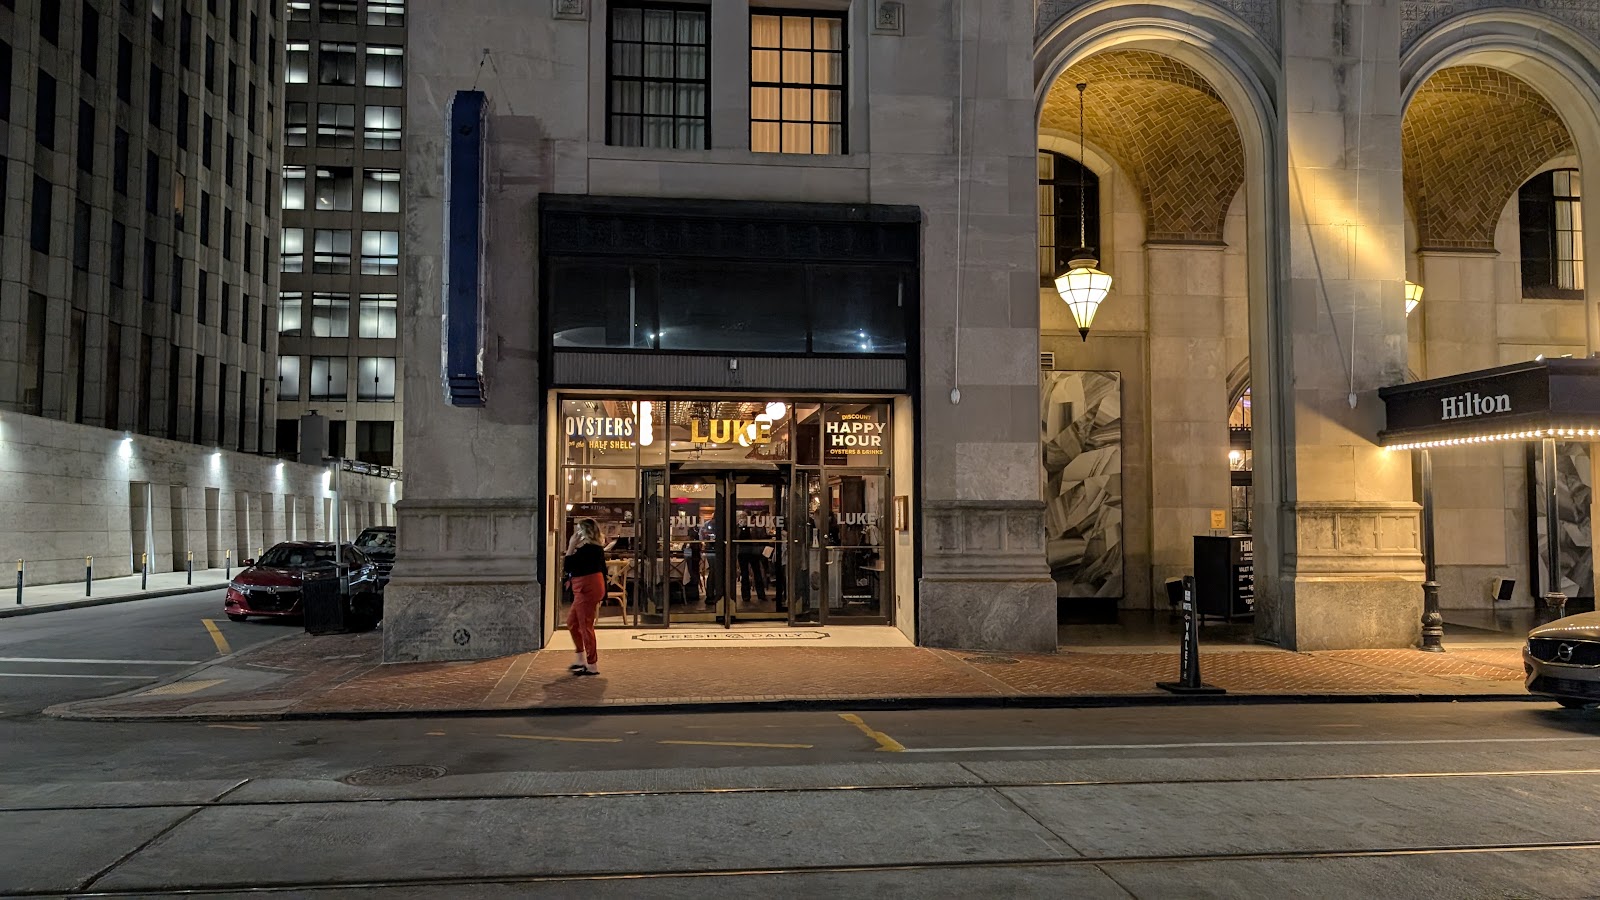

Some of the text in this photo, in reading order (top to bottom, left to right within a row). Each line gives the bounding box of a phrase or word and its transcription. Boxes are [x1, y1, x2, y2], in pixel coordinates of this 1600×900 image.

[1441, 392, 1511, 420] Hilton
[565, 416, 633, 437] OYSTERS
[691, 419, 771, 443] LUKE
[826, 421, 886, 434] HAPPY
[589, 440, 608, 449] HALF
[610, 440, 633, 449] SHELL
[831, 435, 882, 447] HOUR
[746, 515, 785, 528] LUKE
[837, 512, 876, 525] LUKE
